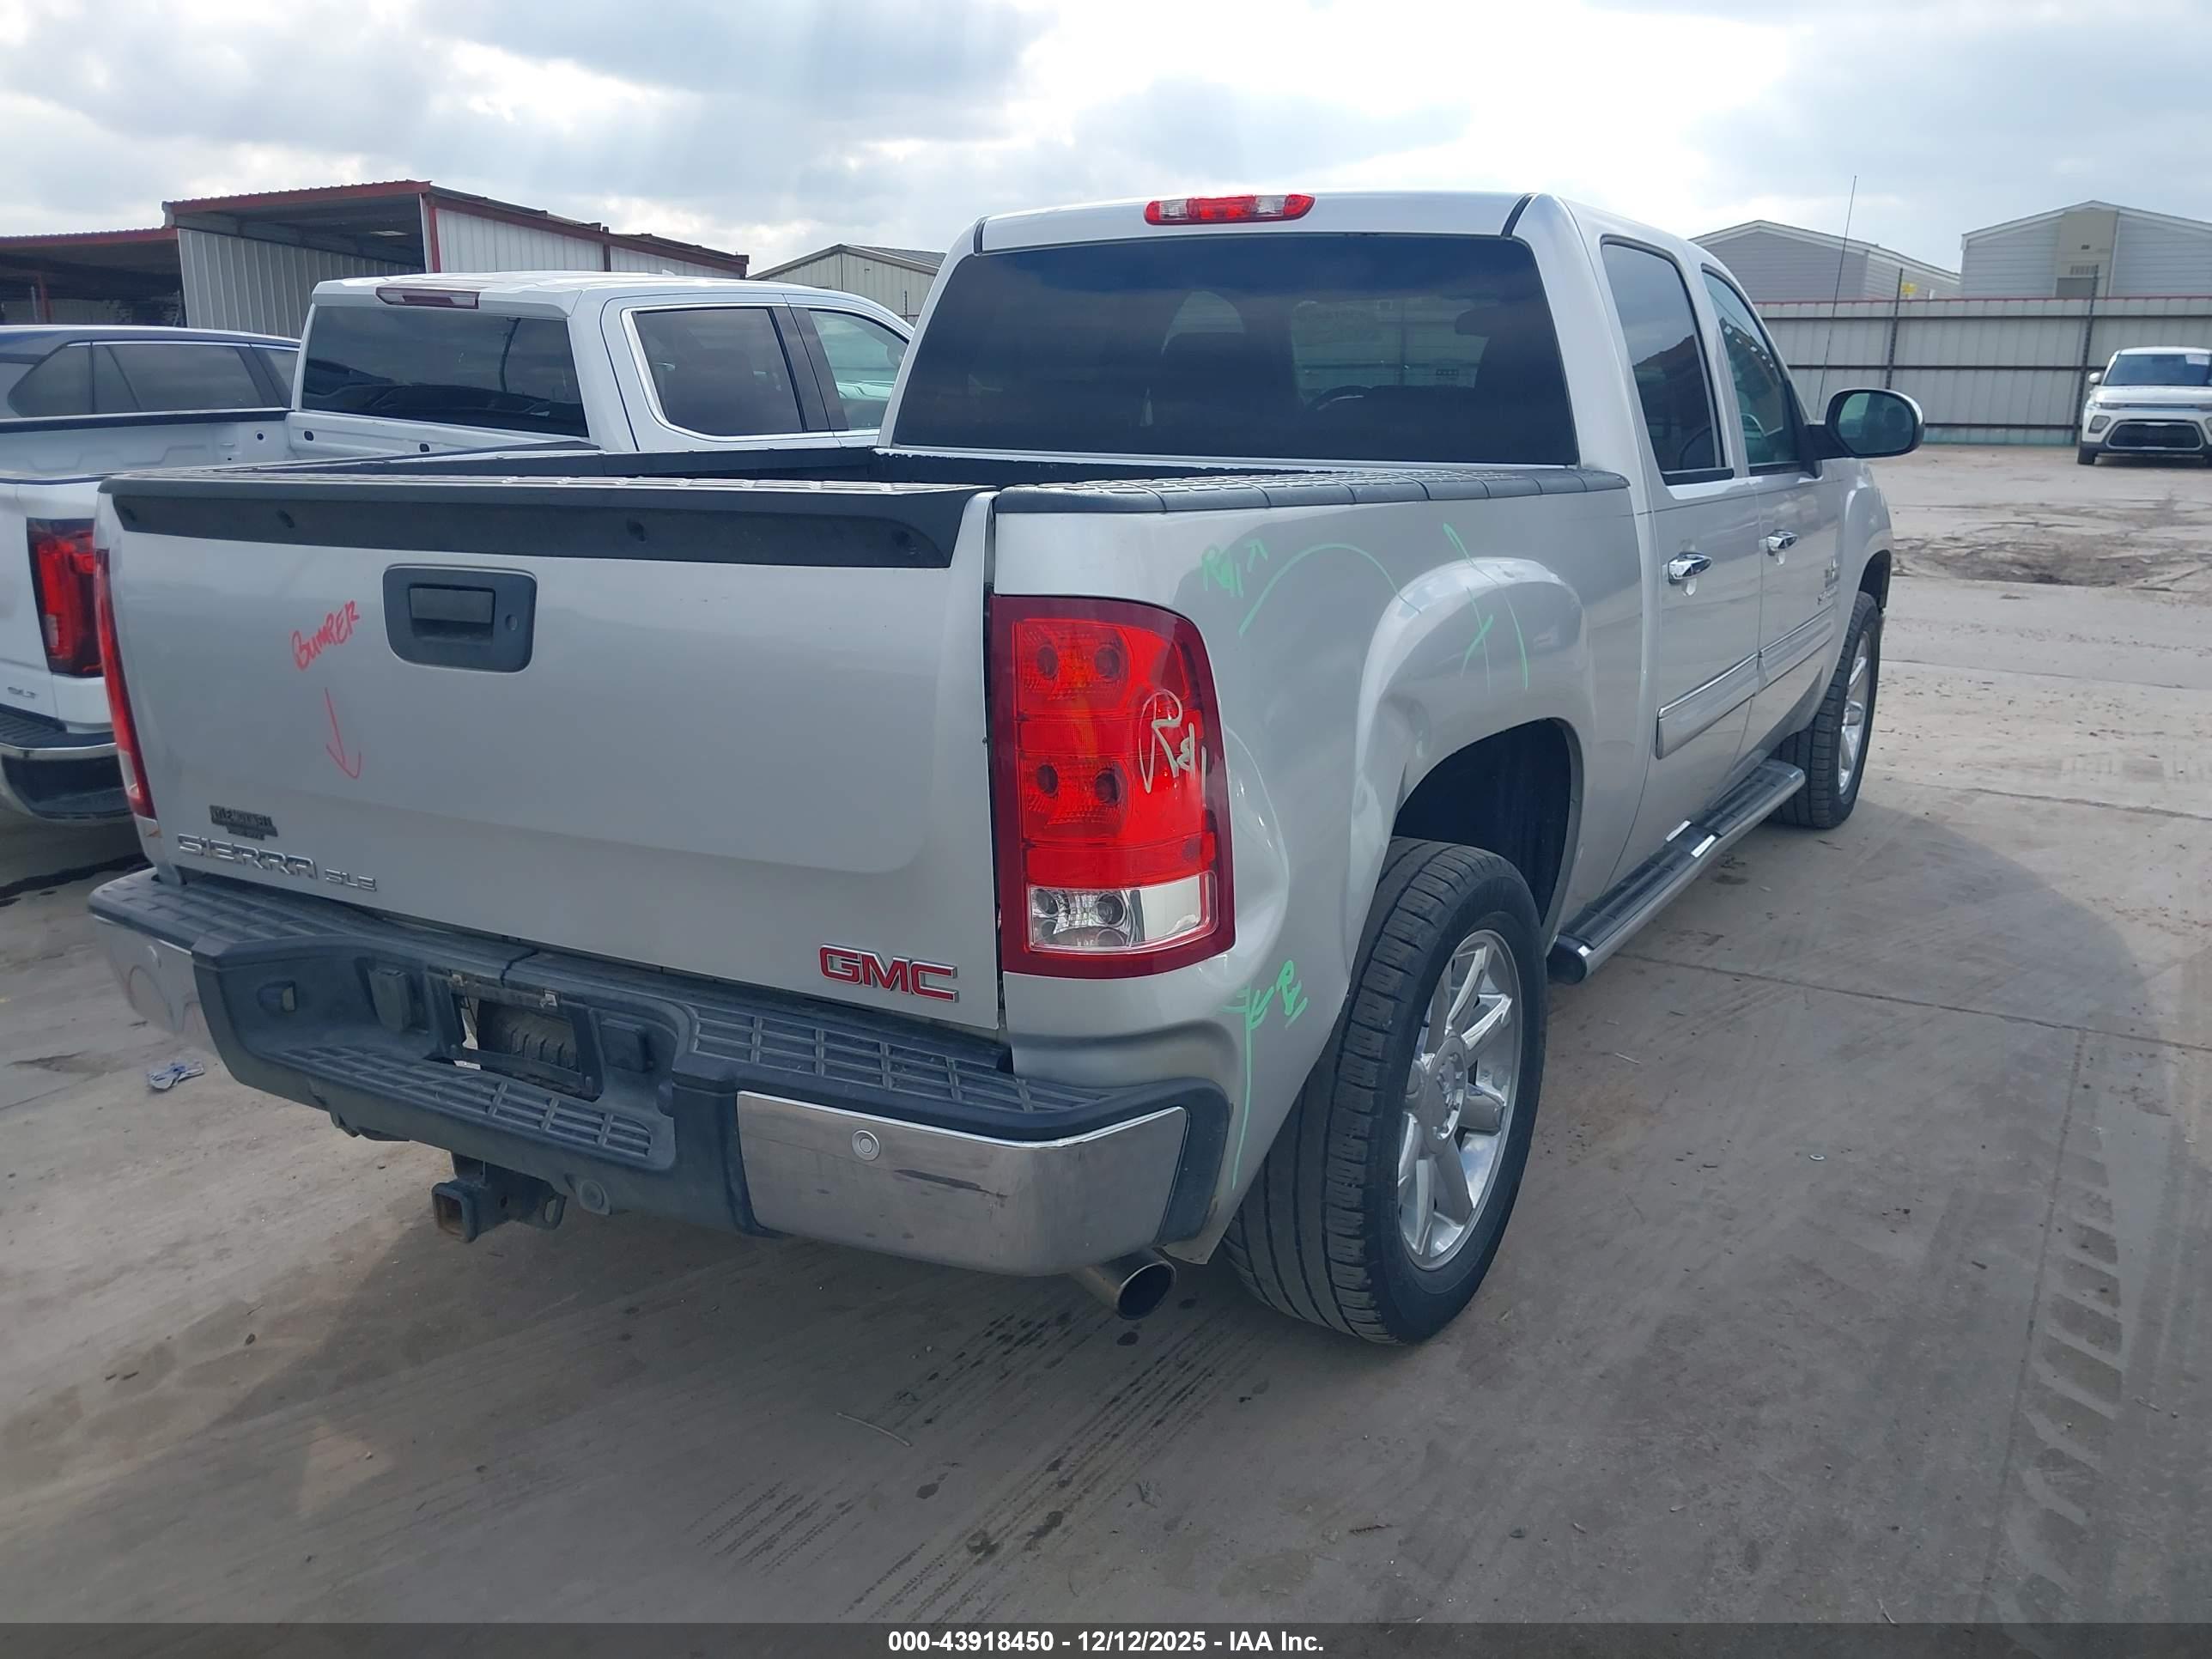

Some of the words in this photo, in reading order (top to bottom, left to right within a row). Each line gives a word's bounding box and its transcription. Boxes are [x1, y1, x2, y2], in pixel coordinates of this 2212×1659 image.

[177, 833, 318, 879] SIERRA
[325, 868, 377, 892] SLE
[818, 944, 959, 1003] GMC
